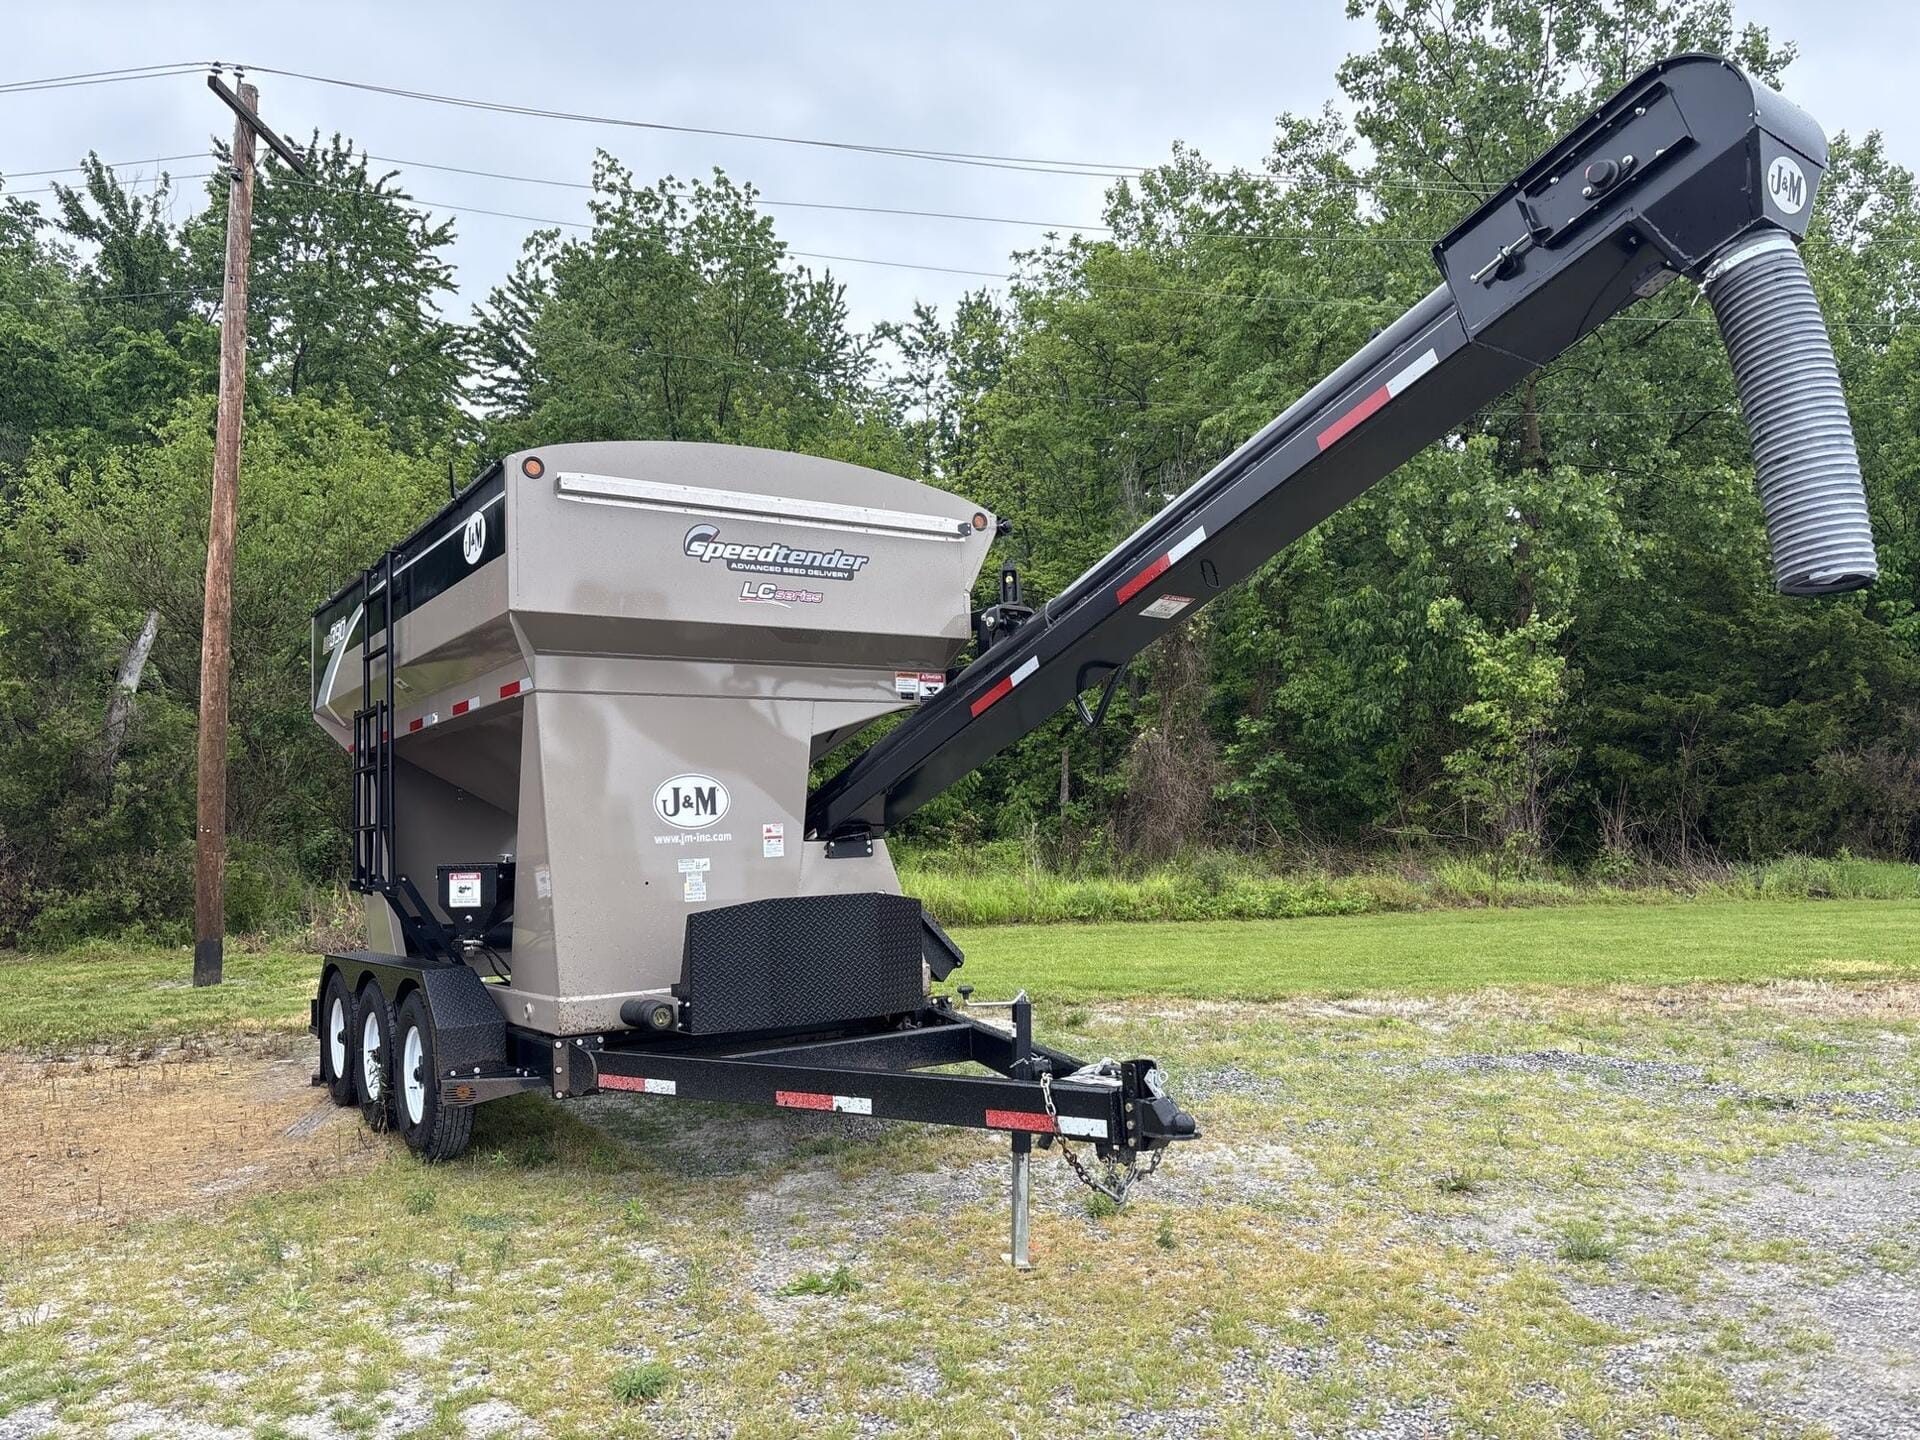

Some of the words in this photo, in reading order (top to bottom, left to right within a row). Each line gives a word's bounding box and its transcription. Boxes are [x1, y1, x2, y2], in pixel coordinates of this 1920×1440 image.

[1771, 165, 1802, 207] J&M
[465, 518, 482, 557] J&M
[731, 562, 781, 573] ADVANCED
[783, 567, 806, 575] SEED
[808, 569, 849, 579] DELIVERY
[661, 786, 718, 817] J&M
[654, 833, 732, 846] www.jm-inc.com
